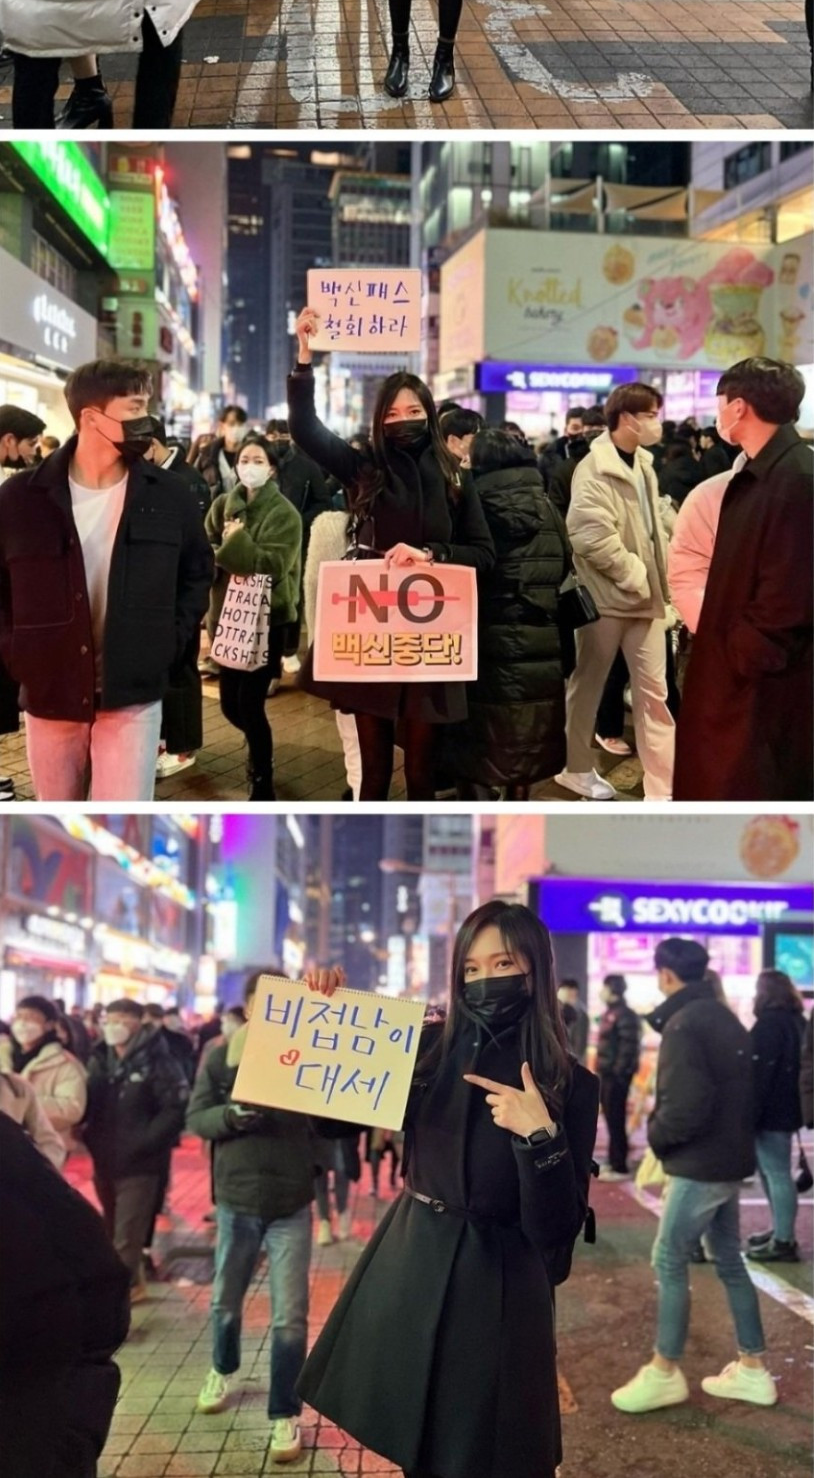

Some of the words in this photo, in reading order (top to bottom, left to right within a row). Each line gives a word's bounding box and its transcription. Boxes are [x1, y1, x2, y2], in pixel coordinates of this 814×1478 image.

[320, 280, 410, 307] 백신패스
[324, 314, 408, 341] 철회하라
[347, 573, 446, 624] NO
[331, 632, 463, 666] 백신중단!
[264, 993, 414, 1055] 비접남이
[295, 1063, 391, 1111] 대세
